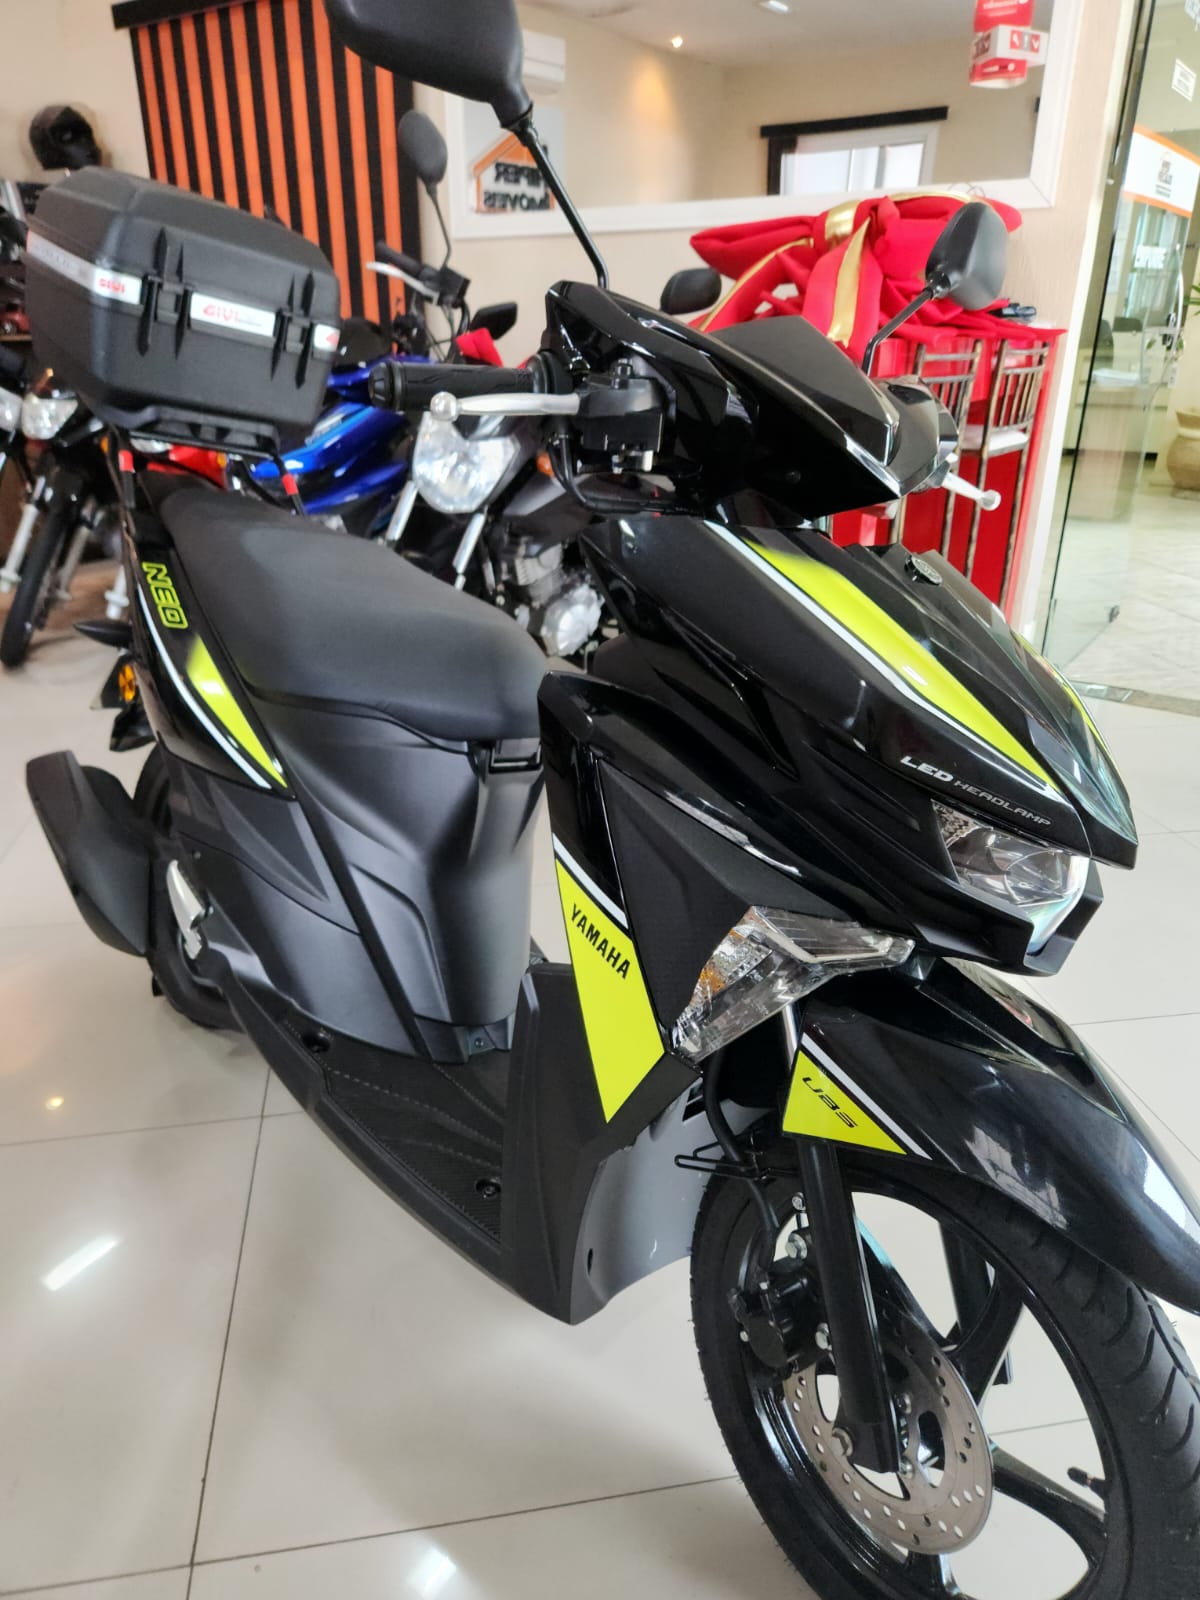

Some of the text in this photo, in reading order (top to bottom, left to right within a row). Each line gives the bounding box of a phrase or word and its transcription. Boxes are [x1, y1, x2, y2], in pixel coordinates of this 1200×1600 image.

[142, 562, 188, 629] NEO
[900, 755, 1052, 826] LED HEADLAMP
[571, 903, 631, 980] YAMAHA
[802, 1076, 858, 1128] UBS
